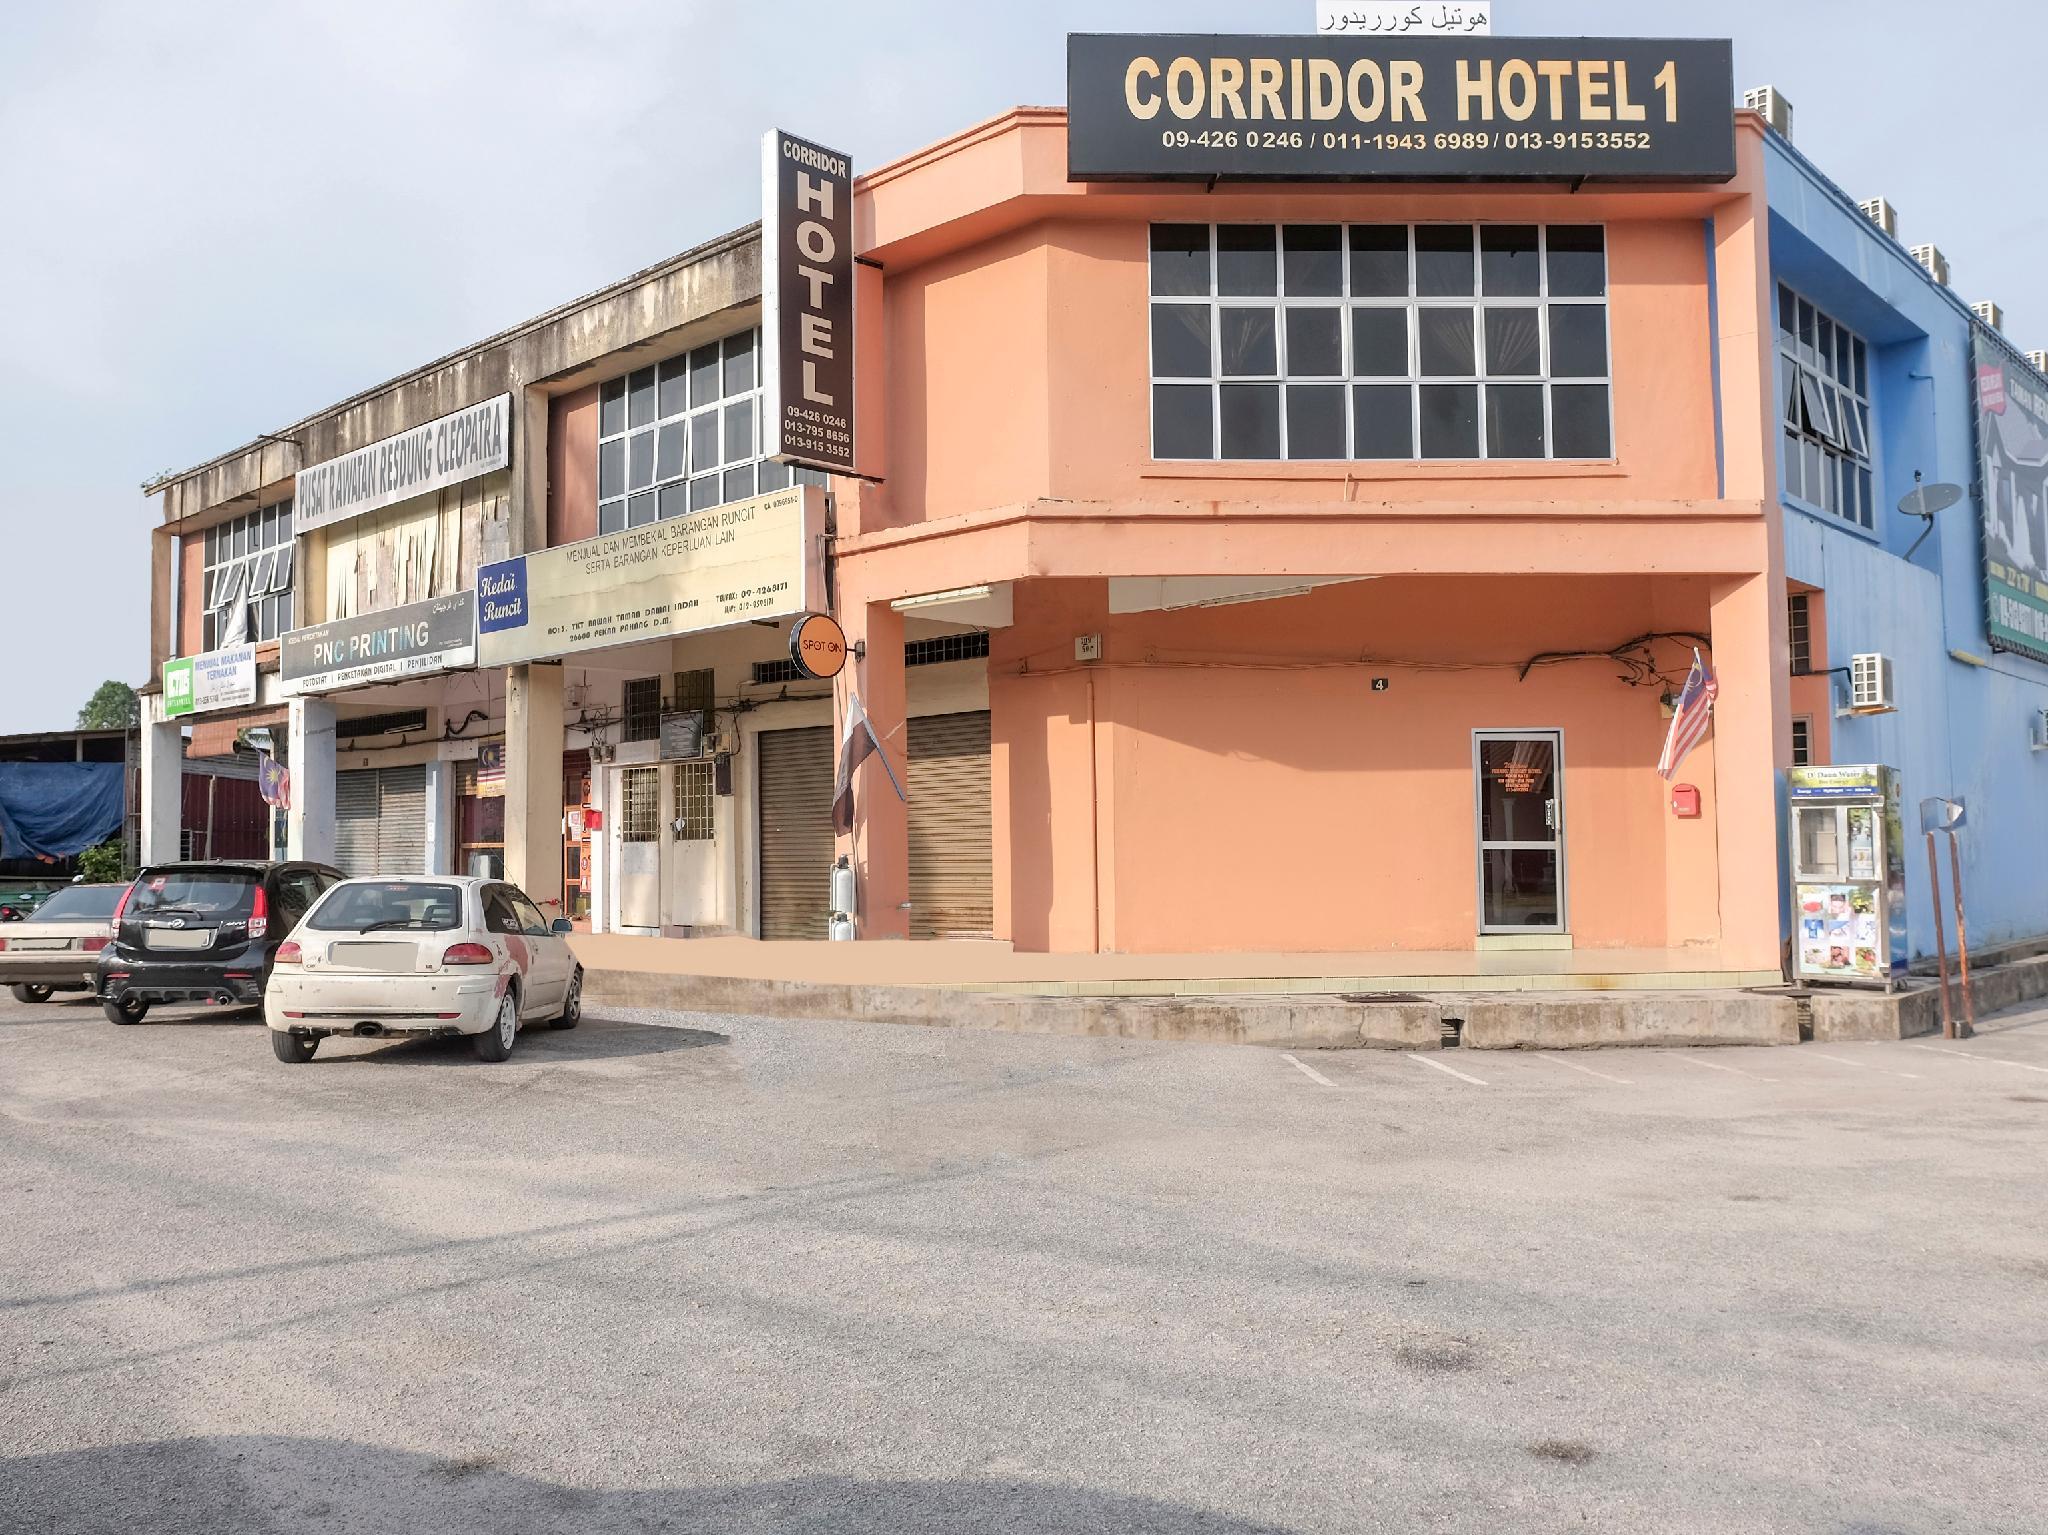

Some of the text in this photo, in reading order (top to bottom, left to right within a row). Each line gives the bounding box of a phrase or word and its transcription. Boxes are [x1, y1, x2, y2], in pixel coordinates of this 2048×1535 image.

[1431, 5, 1488, 31] هوتيل
[1124, 55, 1677, 123] CORRIDOR HOTEL 1
[1162, 131, 1238, 149] 09-426
[1323, 131, 1427, 150] 011-1943
[1433, 132, 1489, 150] 6989
[1504, 131, 1651, 150] 013-9153552
[783, 140, 847, 179] CORRIDOR
[796, 170, 836, 407] HOTEL
[787, 405, 847, 428] 09-426 0246
[784, 419, 850, 443] 013-795 8656
[784, 434, 850, 458] 013-915 3552
[299, 403, 501, 521] PUSAT RAWATAN RESDUNG CLEOPATRA
[566, 506, 756, 563] MENJUAL DAN MEMBEKAL BARANGAN RUNCIT
[585, 529, 735, 575] SERTA BARANGAN KEPERLUAN LAIN
[480, 573, 516, 597] Kedai
[484, 598, 522, 622] Runcit
[616, 610, 641, 622] TAMAN
[674, 599, 699, 611] INDAH
[569, 631, 591, 642] 26600
[594, 627, 616, 638] PEKAN
[619, 621, 649, 633] PAHANG
[313, 621, 429, 667] PNC PRINTING
[803, 639, 842, 653] SPOT ON
[302, 675, 328, 688] FOTOSTAT
[1375, 679, 1384, 690] 4
